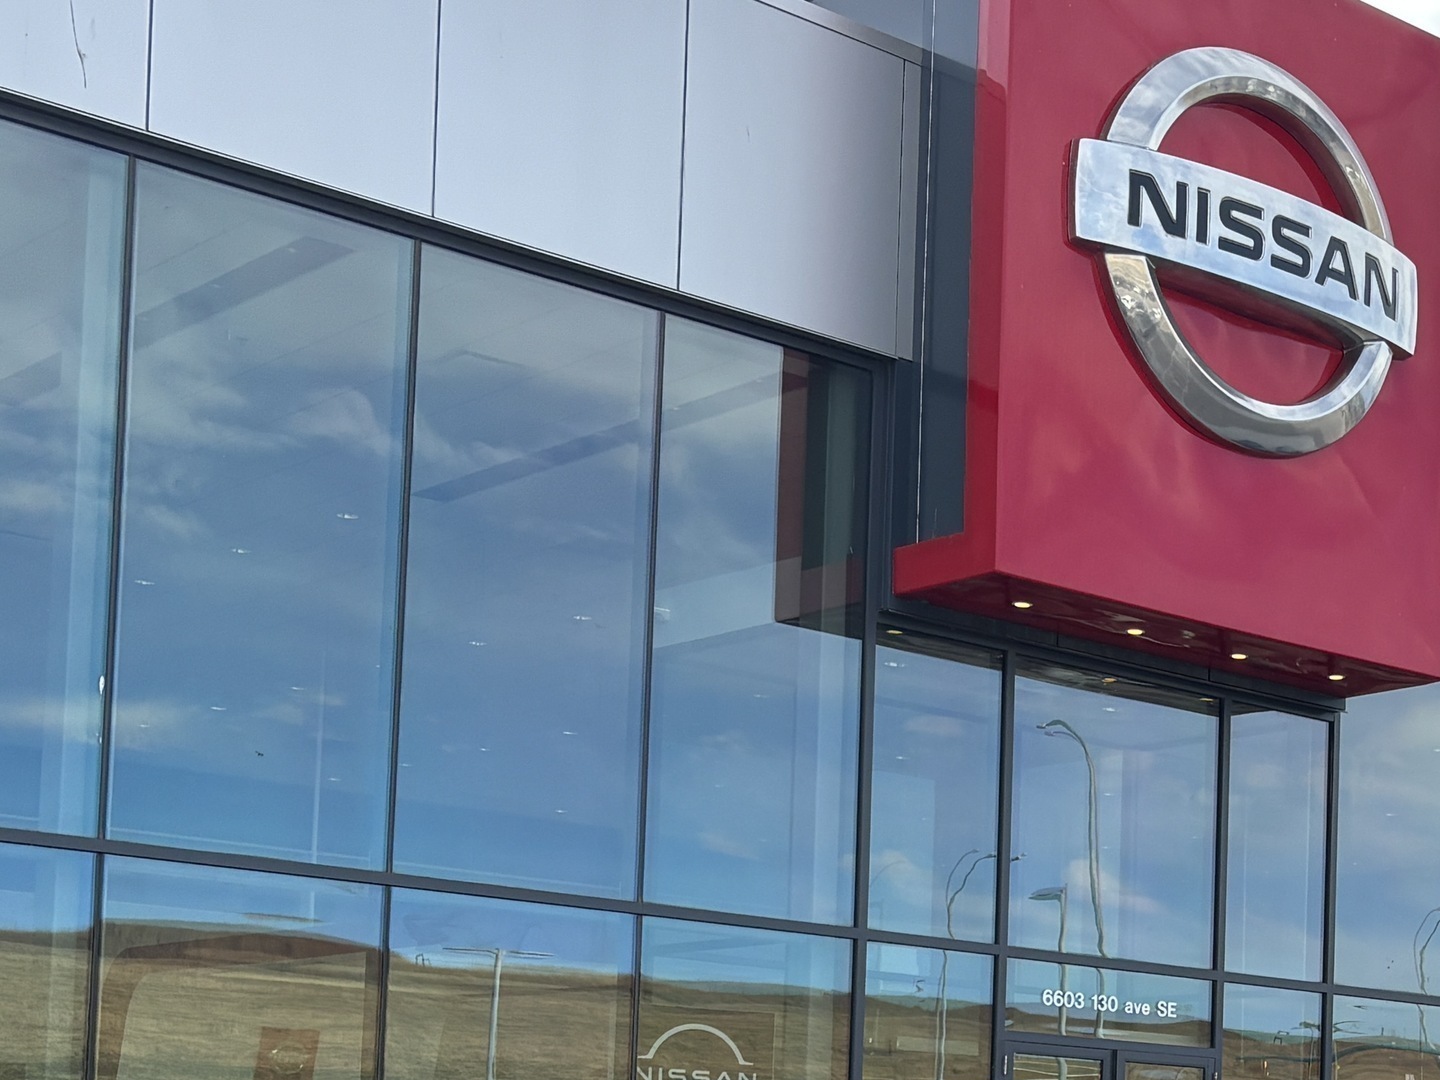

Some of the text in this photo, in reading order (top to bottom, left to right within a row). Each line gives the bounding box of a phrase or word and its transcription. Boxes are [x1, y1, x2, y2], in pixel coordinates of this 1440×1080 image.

[1128, 168, 1399, 322] NISSAN
[1042, 989, 1177, 1018] 6603 130 ave SE
